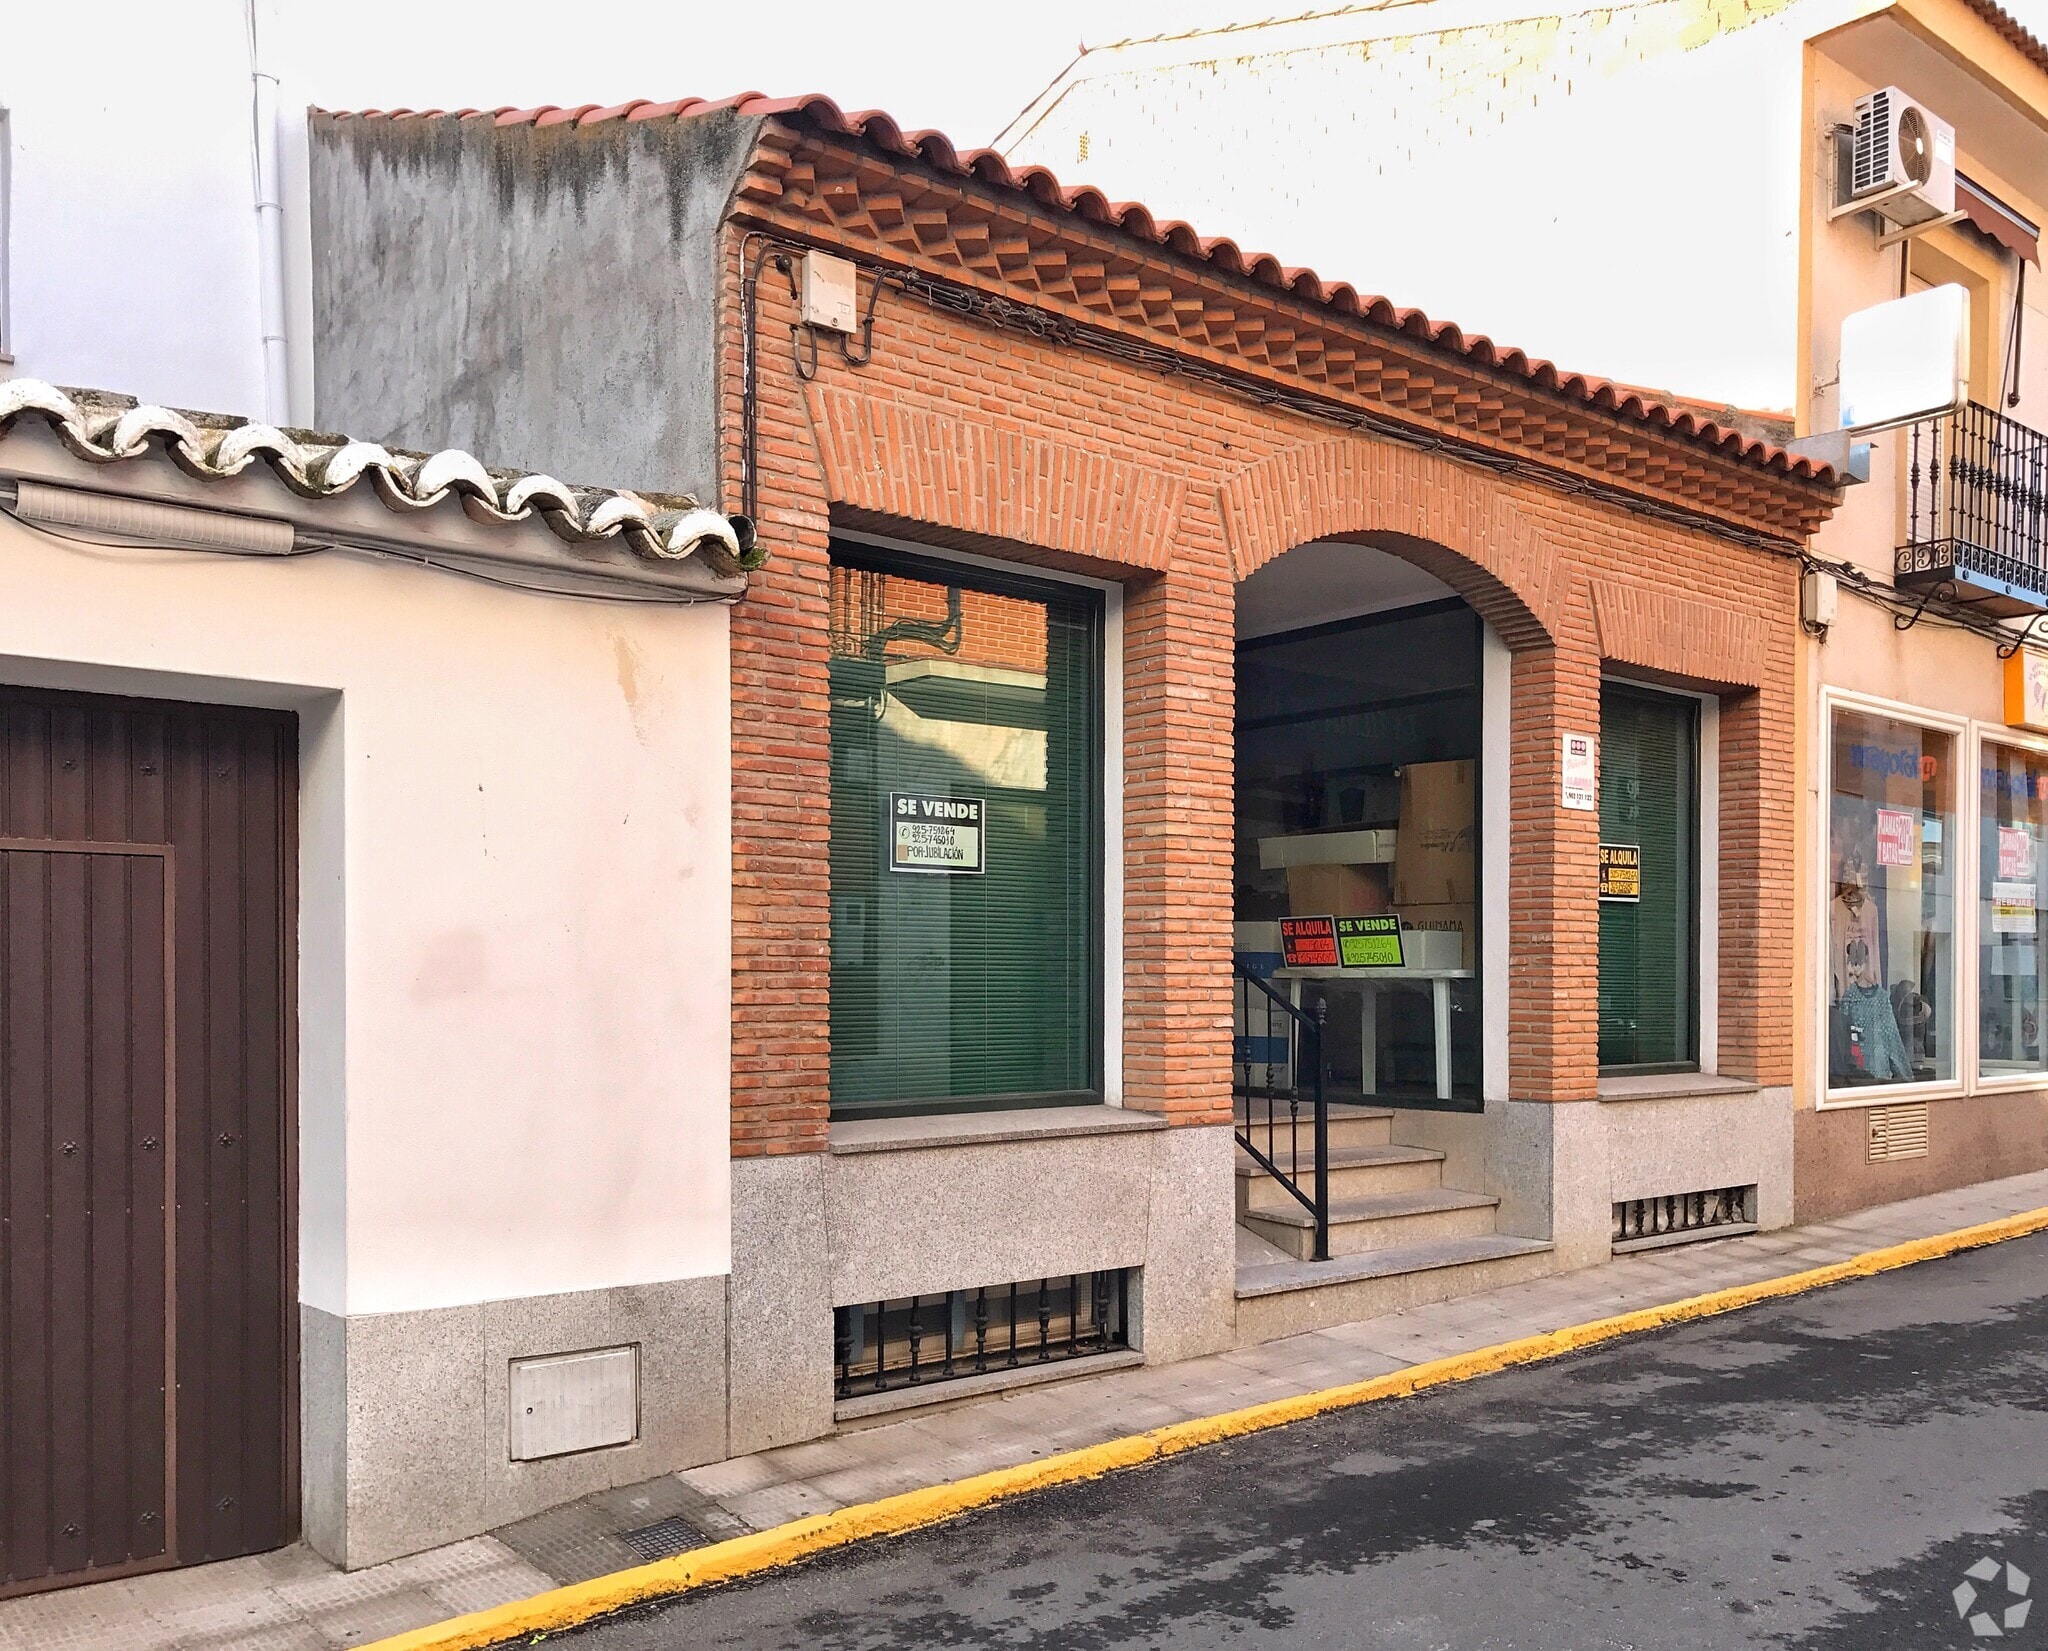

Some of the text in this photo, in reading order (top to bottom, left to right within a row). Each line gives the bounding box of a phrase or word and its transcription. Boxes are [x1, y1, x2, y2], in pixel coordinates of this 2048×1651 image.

[1851, 744, 1919, 780] mayoral
[897, 798, 978, 820] SE VENDE
[1600, 848, 1638, 865] SE ALQUILA
[1995, 898, 2032, 907] REBAJAS
[1282, 920, 1332, 936] SE ALQUILA
[1339, 918, 1397, 932] SE VENDE
